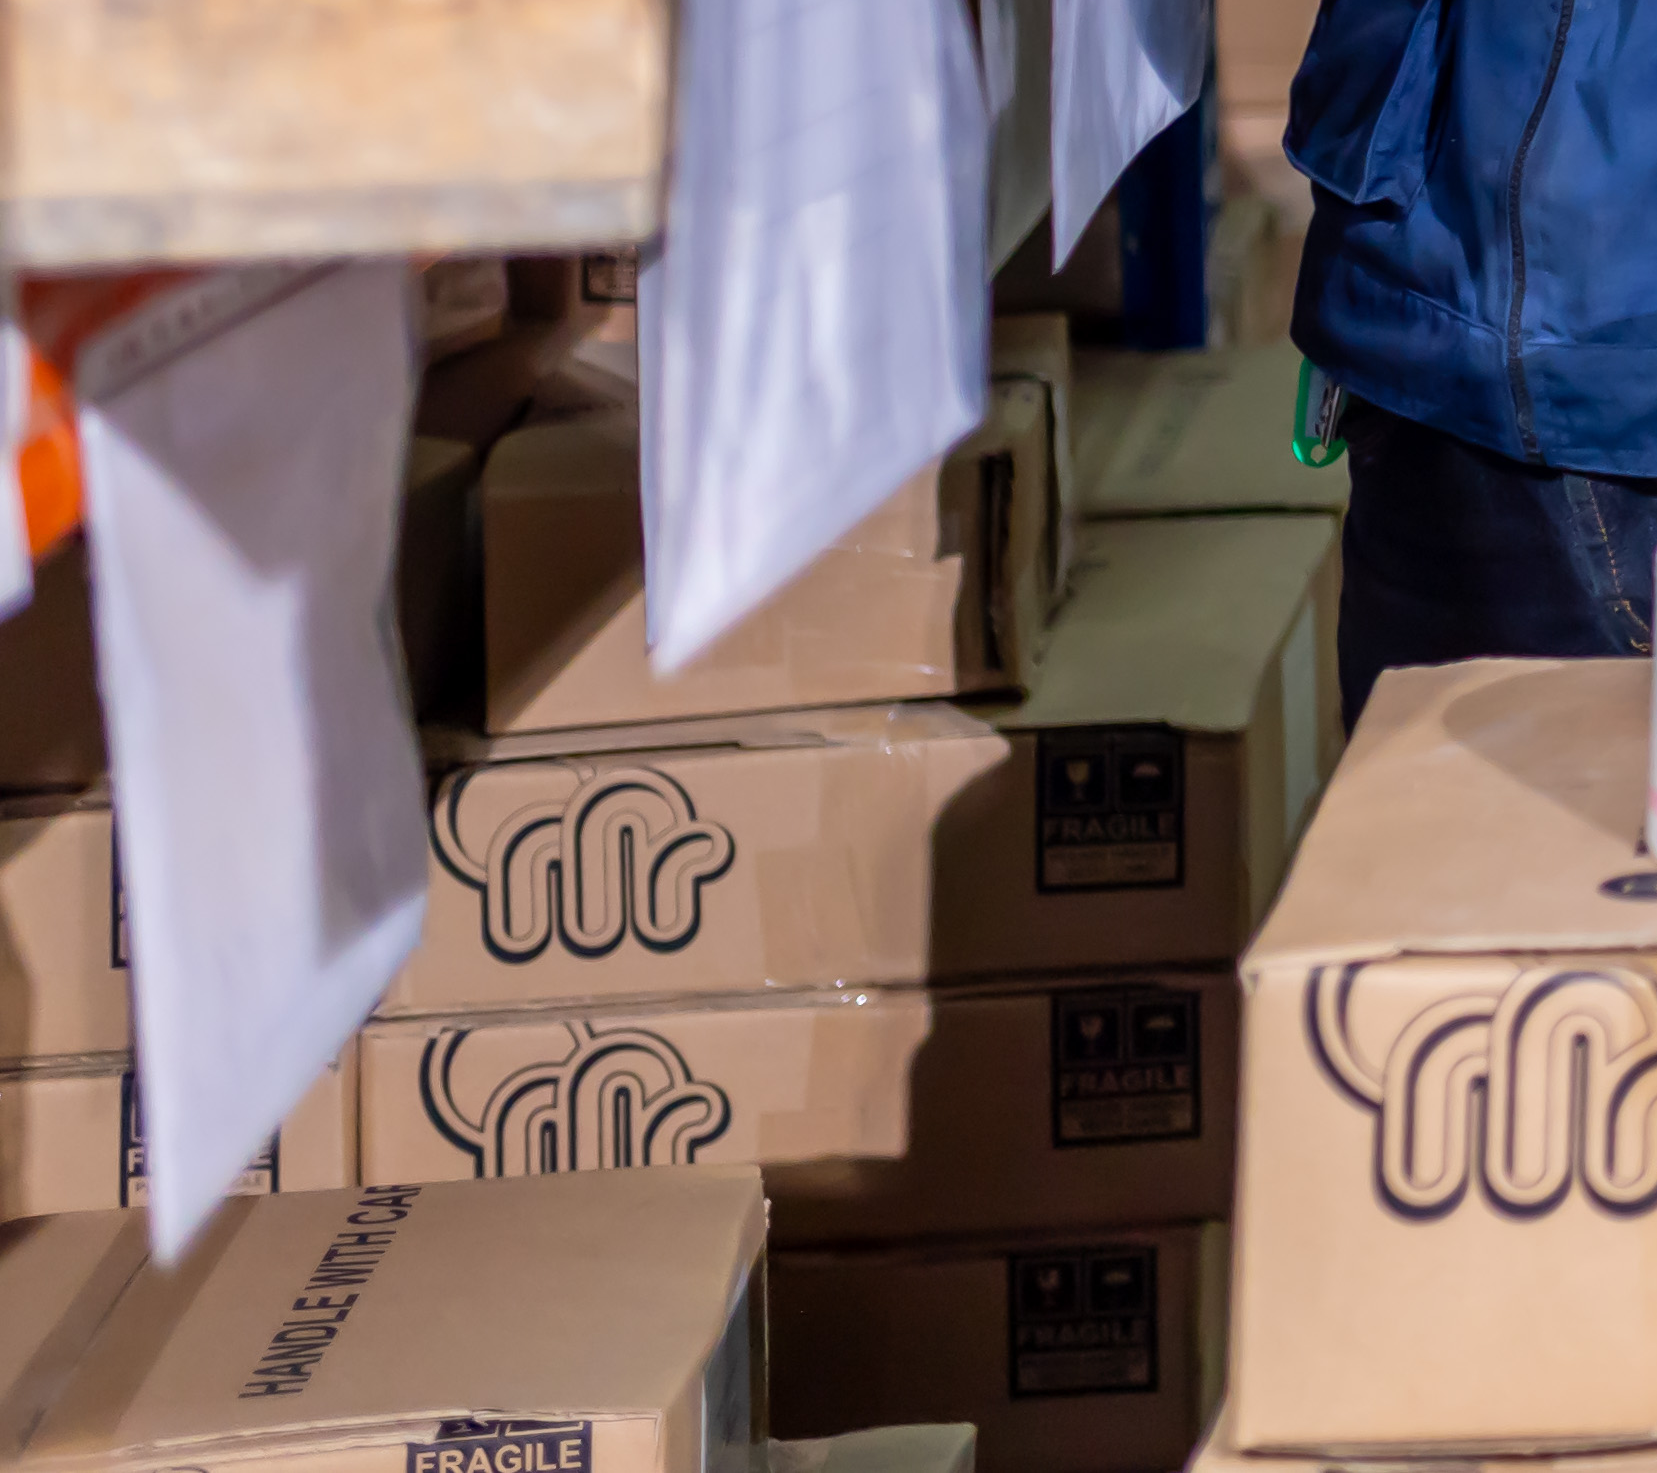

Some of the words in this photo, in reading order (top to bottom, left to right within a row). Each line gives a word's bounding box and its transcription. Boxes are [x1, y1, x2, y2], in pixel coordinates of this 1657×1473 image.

[238, 1293, 360, 1399] HANDLE
[303, 1230, 397, 1291] WITH
[415, 1439, 583, 1473] FRAGILE
